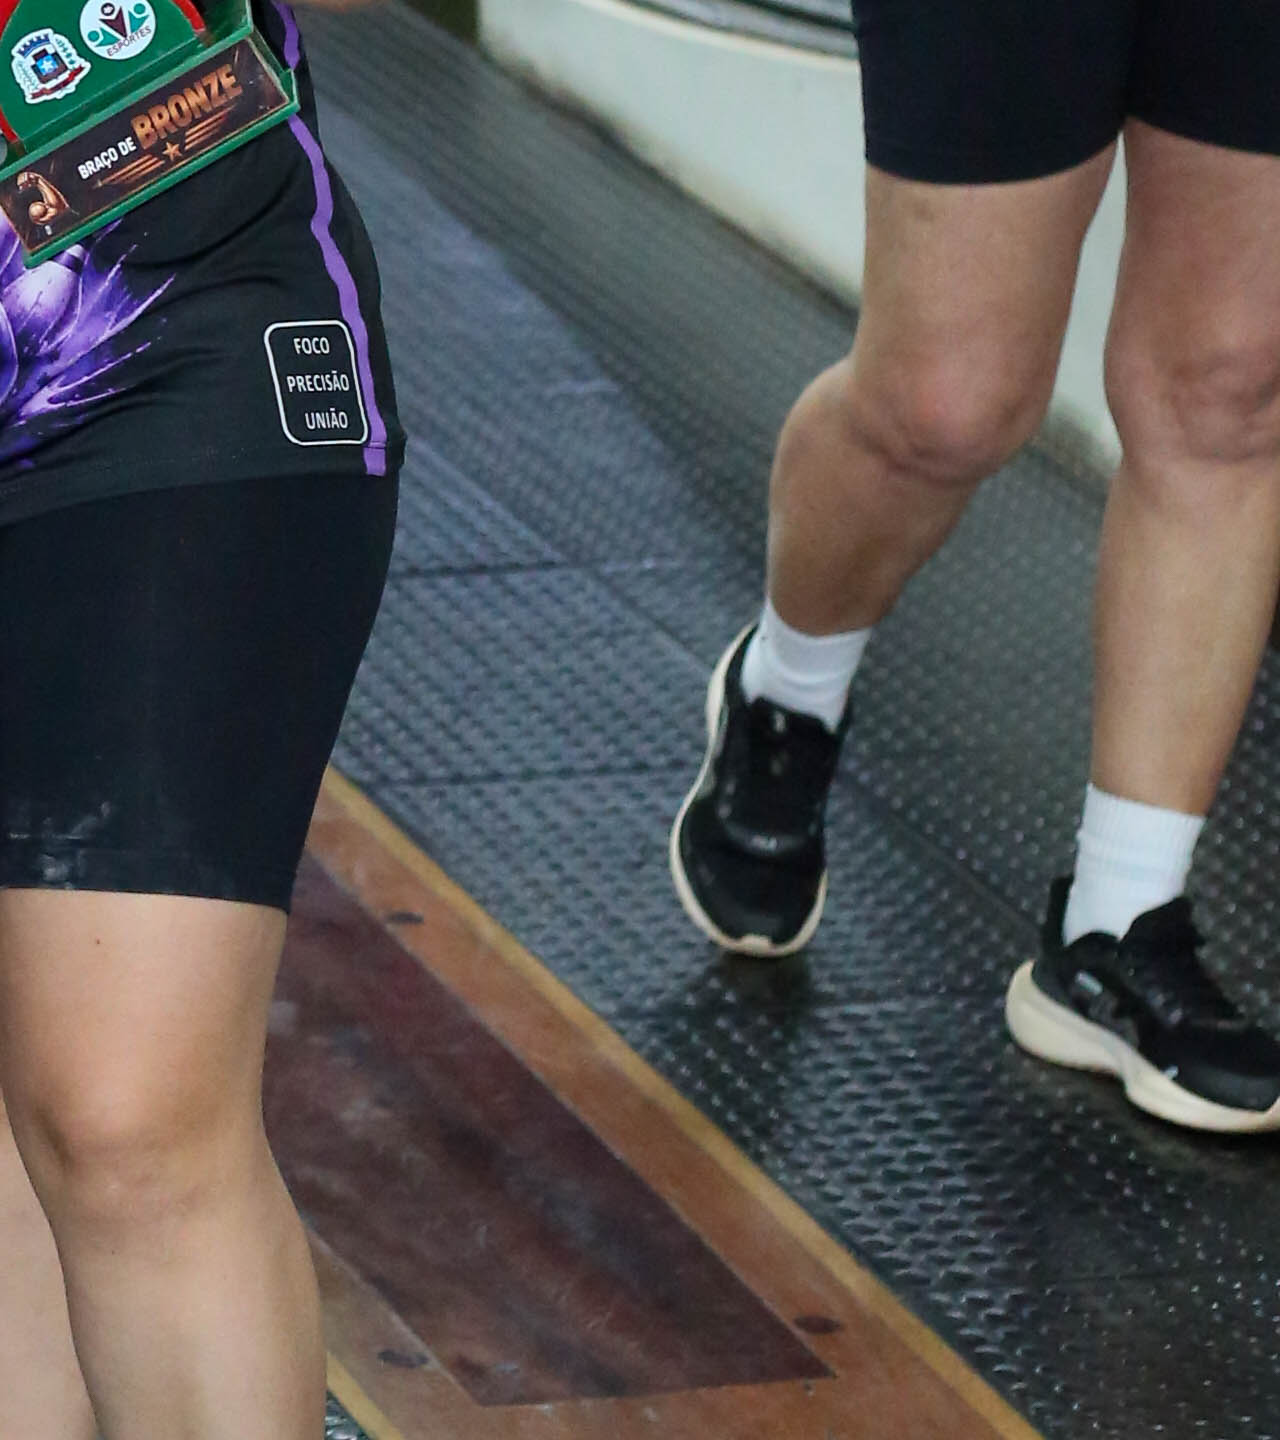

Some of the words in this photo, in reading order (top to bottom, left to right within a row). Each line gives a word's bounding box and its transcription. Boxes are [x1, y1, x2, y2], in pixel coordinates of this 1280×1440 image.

[107, 25, 152, 58] ESPORTES
[78, 147, 119, 181] BRAÇO
[119, 136, 137, 156] DE
[131, 64, 243, 150] BRONZE
[293, 337, 330, 355] FOCO
[286, 370, 350, 393] PRECISÃO
[304, 408, 348, 430] UNIÃO
